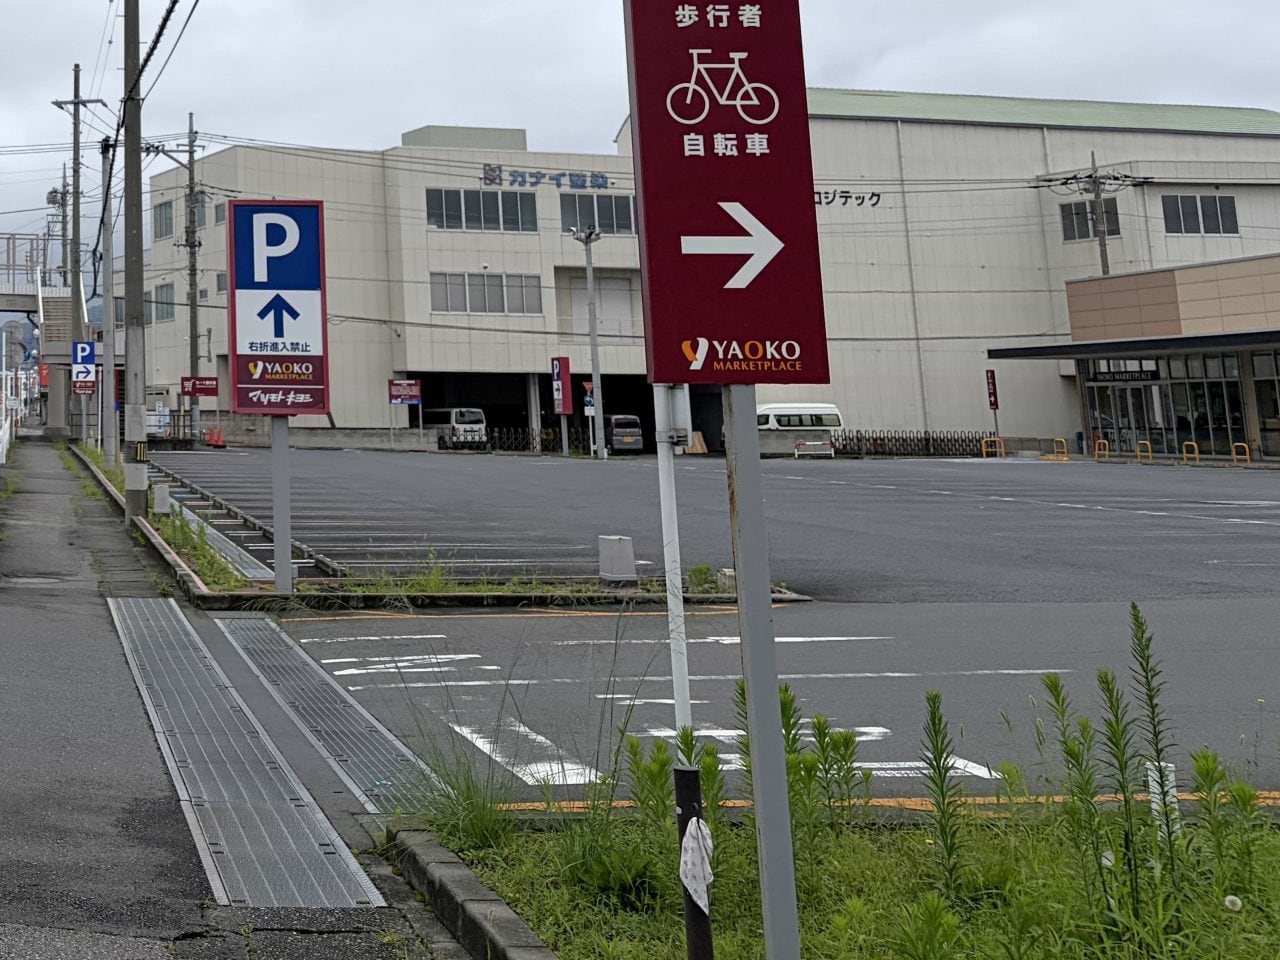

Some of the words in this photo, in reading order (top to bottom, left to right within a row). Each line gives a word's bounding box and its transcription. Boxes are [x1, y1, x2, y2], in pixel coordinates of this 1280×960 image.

[675, 4, 762, 28] 歩行者
[683, 133, 770, 156] 自転車
[252, 212, 301, 283] P
[76, 343, 91, 363] P
[248, 341, 311, 353] 右折進入禁止
[712, 340, 801, 359] YAOKO
[264, 362, 313, 374] YAOKO
[713, 360, 802, 371] MARKETPLACE
[265, 373, 313, 381] MARKETPLACE
[248, 390, 314, 405] マツモトキヨシ
